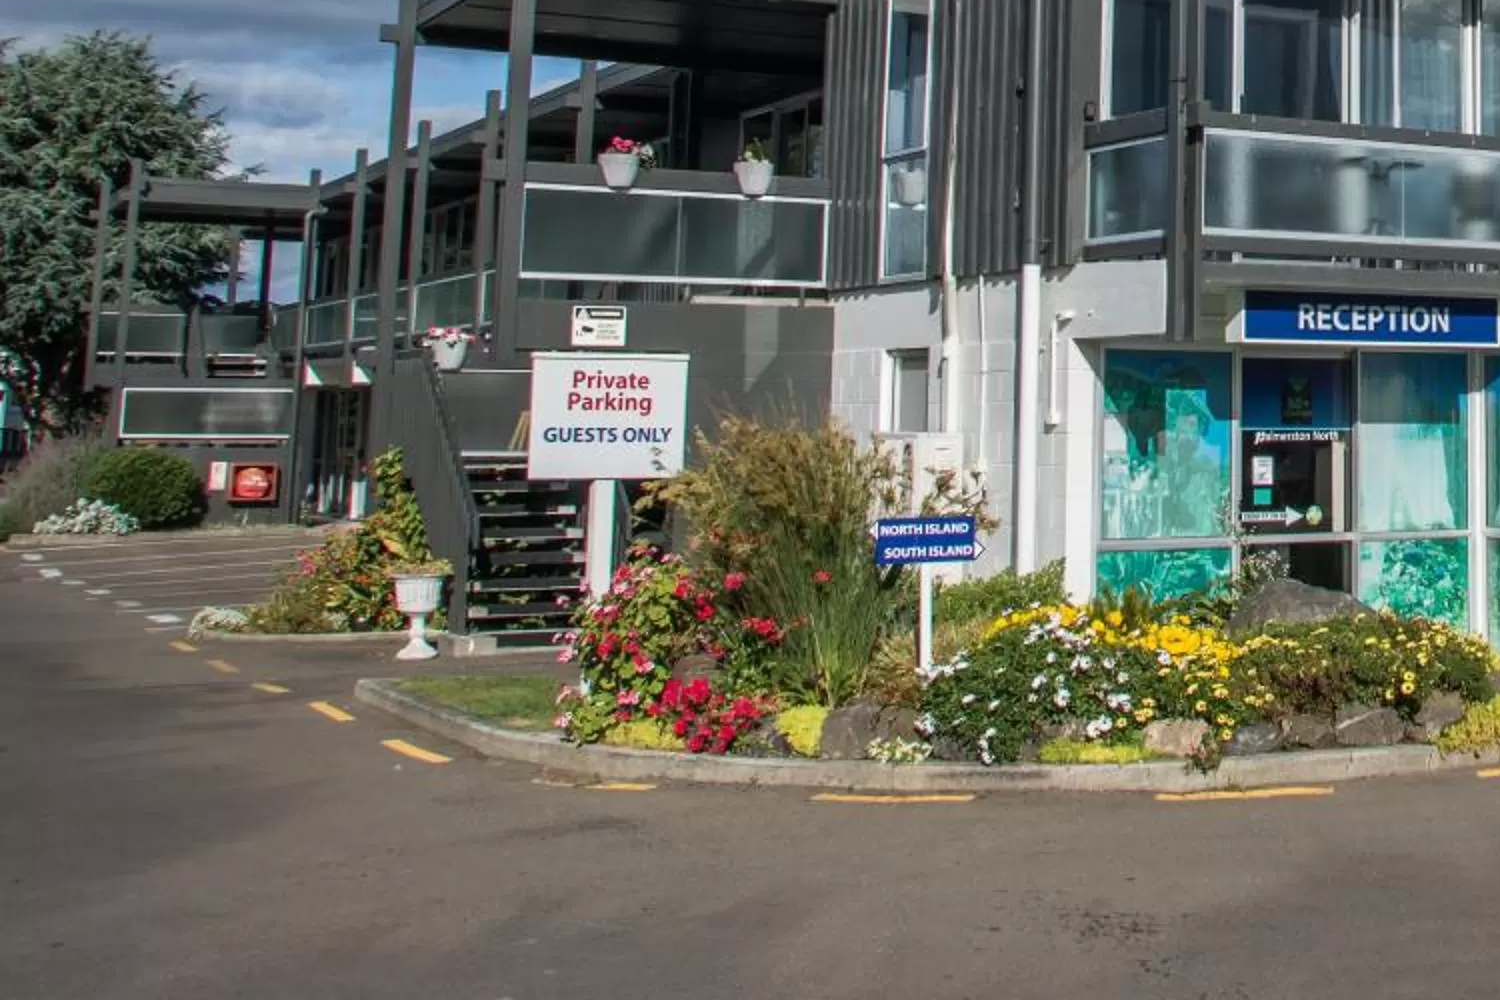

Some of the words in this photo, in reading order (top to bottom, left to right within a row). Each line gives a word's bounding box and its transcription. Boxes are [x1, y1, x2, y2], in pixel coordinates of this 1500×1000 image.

[1298, 303, 1450, 334] RECEPTION
[573, 370, 650, 389] Private
[567, 392, 653, 416] Parking
[543, 427, 618, 443] GUESTS
[622, 427, 672, 443] ONLY
[1313, 430, 1339, 441] North
[880, 524, 923, 537] NORTH
[925, 522, 970, 535] ISLAND
[884, 546, 926, 559] SOUTH
[928, 544, 973, 557] ISLAND
